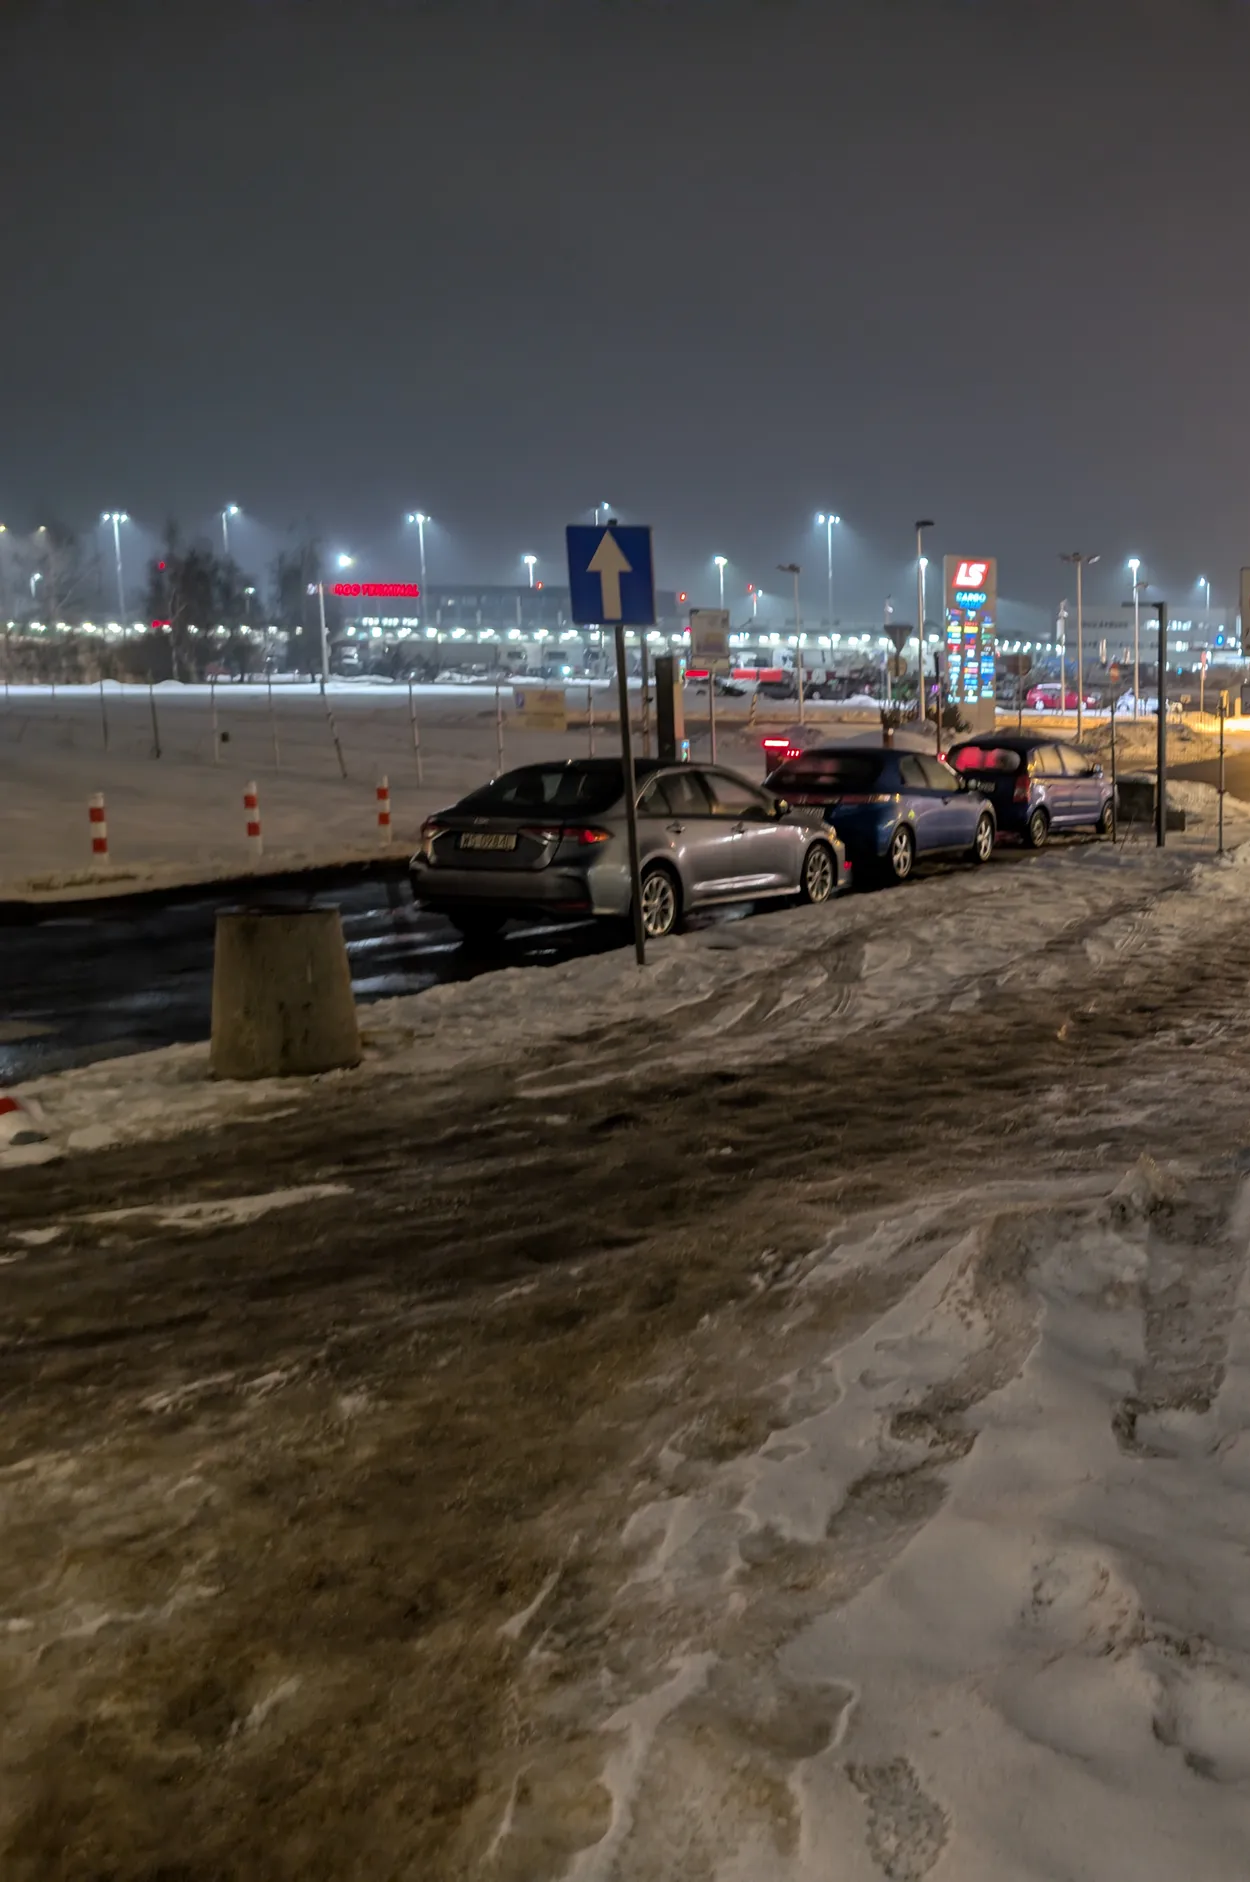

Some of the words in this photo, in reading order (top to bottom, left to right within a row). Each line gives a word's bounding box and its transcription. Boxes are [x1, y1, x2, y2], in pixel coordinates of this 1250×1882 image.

[956, 563, 986, 586] LS
[361, 583, 420, 598] TERMINAL
[956, 591, 987, 602] CARGO
